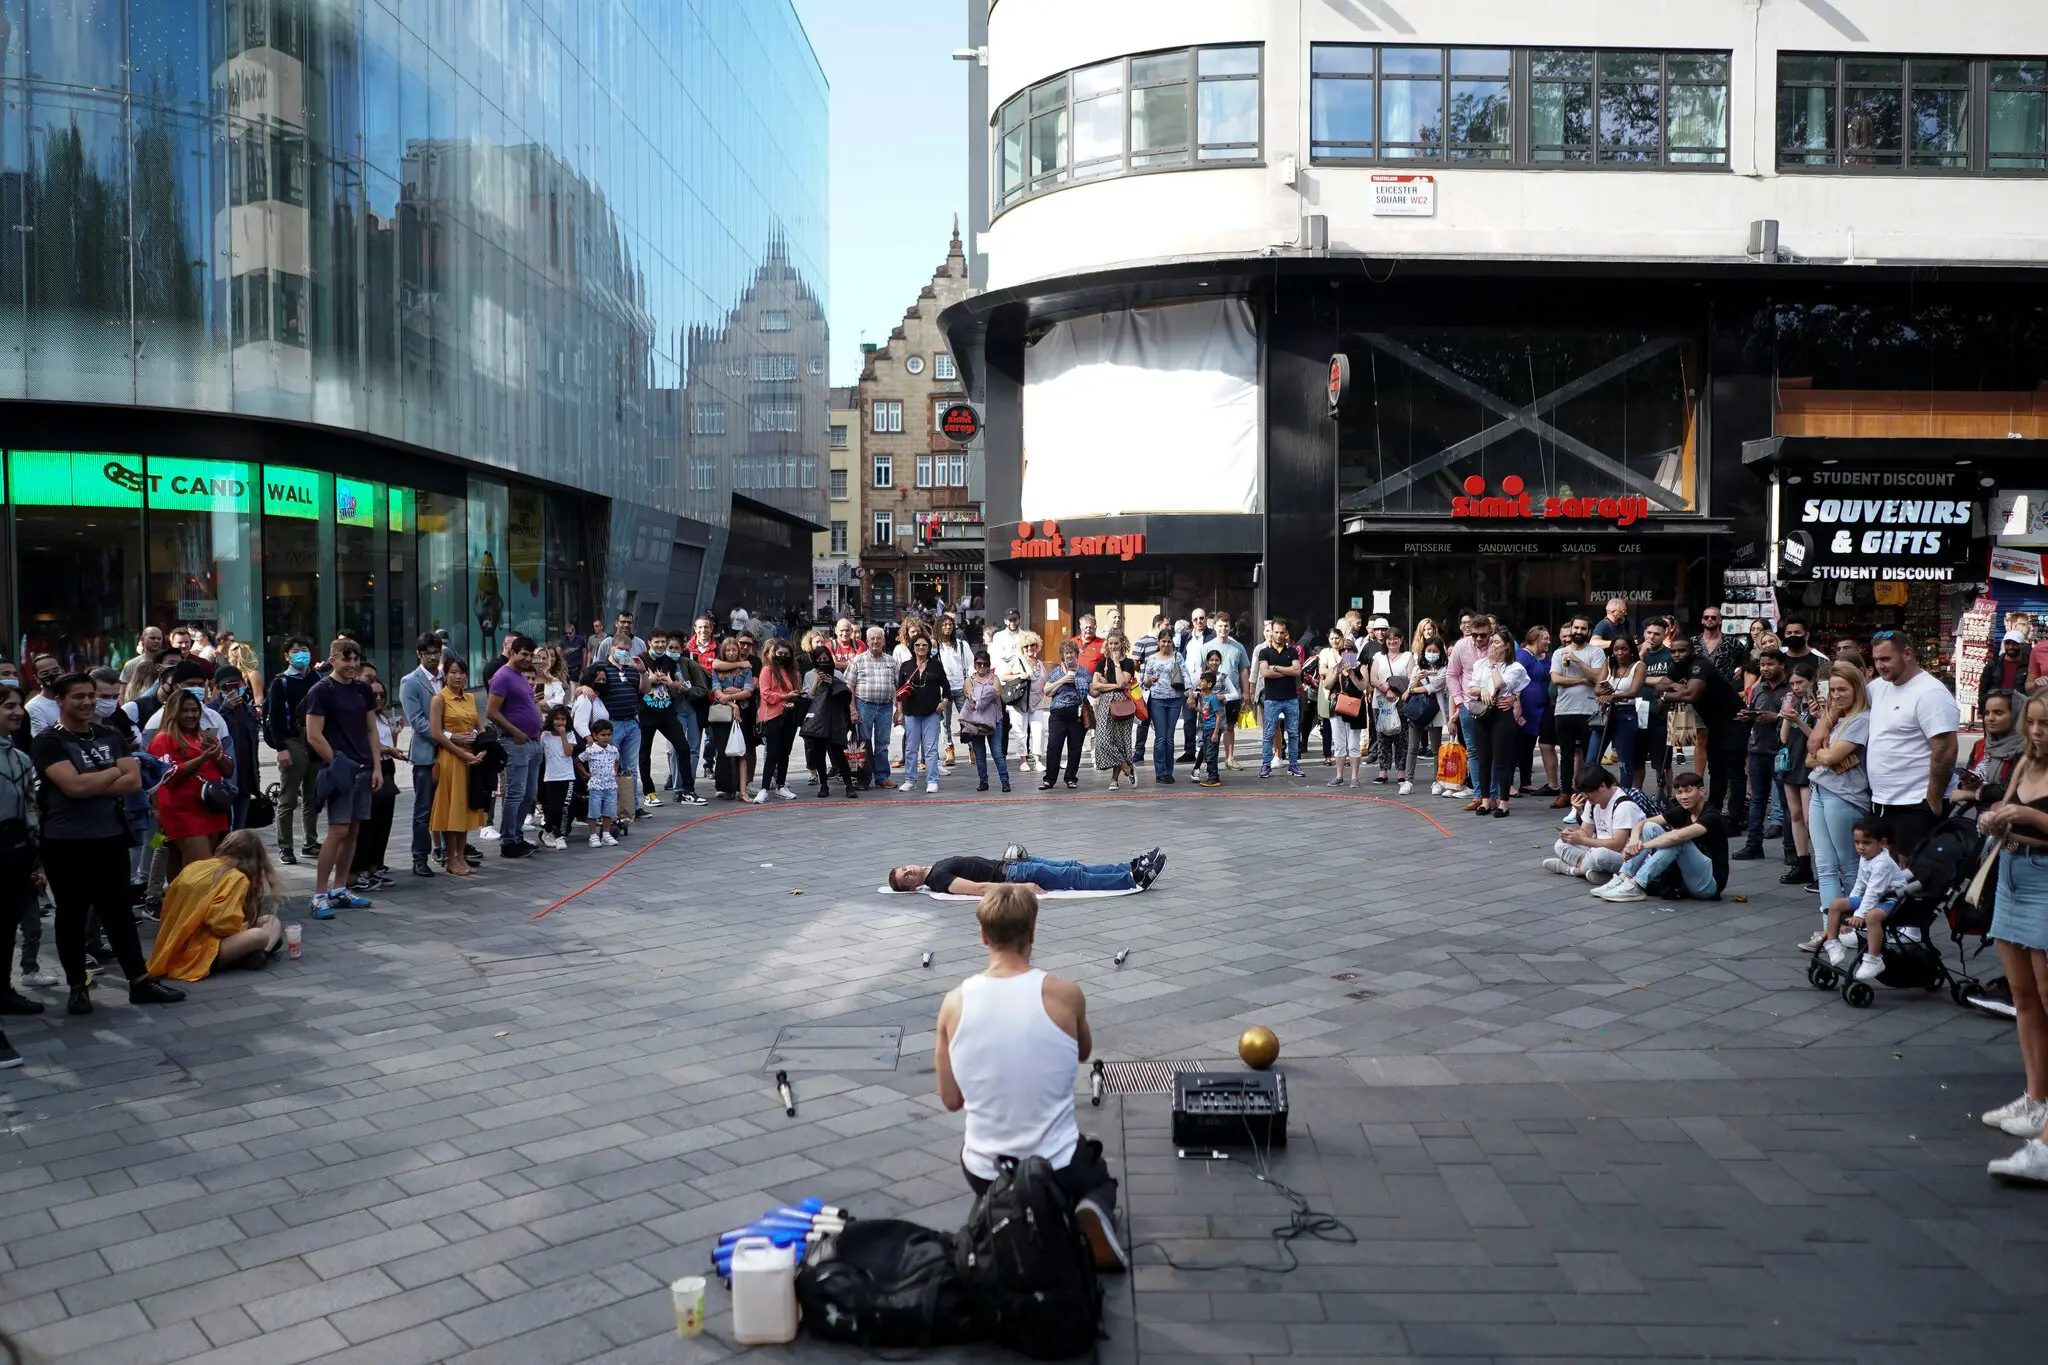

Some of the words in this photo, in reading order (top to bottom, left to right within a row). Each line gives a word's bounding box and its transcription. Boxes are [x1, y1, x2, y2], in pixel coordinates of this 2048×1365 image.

[1376, 186, 1418, 195] LEICESTER
[1376, 196, 1407, 205] SQUARE
[1410, 196, 1428, 205] WC2
[1813, 472, 1880, 485] STUDENT
[1883, 473, 1956, 486] DISCOUNT
[267, 483, 314, 505] WALL
[1451, 475, 1533, 518] simit
[1801, 499, 1972, 524] SOUVENIRS
[1010, 519, 1065, 559] simit
[1831, 530, 1853, 554] &
[1861, 530, 1942, 555] GIFTS
[1404, 543, 1452, 552] PATISSERIE
[1478, 543, 1539, 553] SANDWICHES
[1562, 543, 1597, 553] SALADS
[1618, 544, 1642, 553] CAFE
[924, 563, 945, 571] SLUG
[1812, 566, 1879, 580] STUDENT
[1882, 567, 1954, 581] DISCOUNT
[1629, 590, 1653, 601] CAKE
